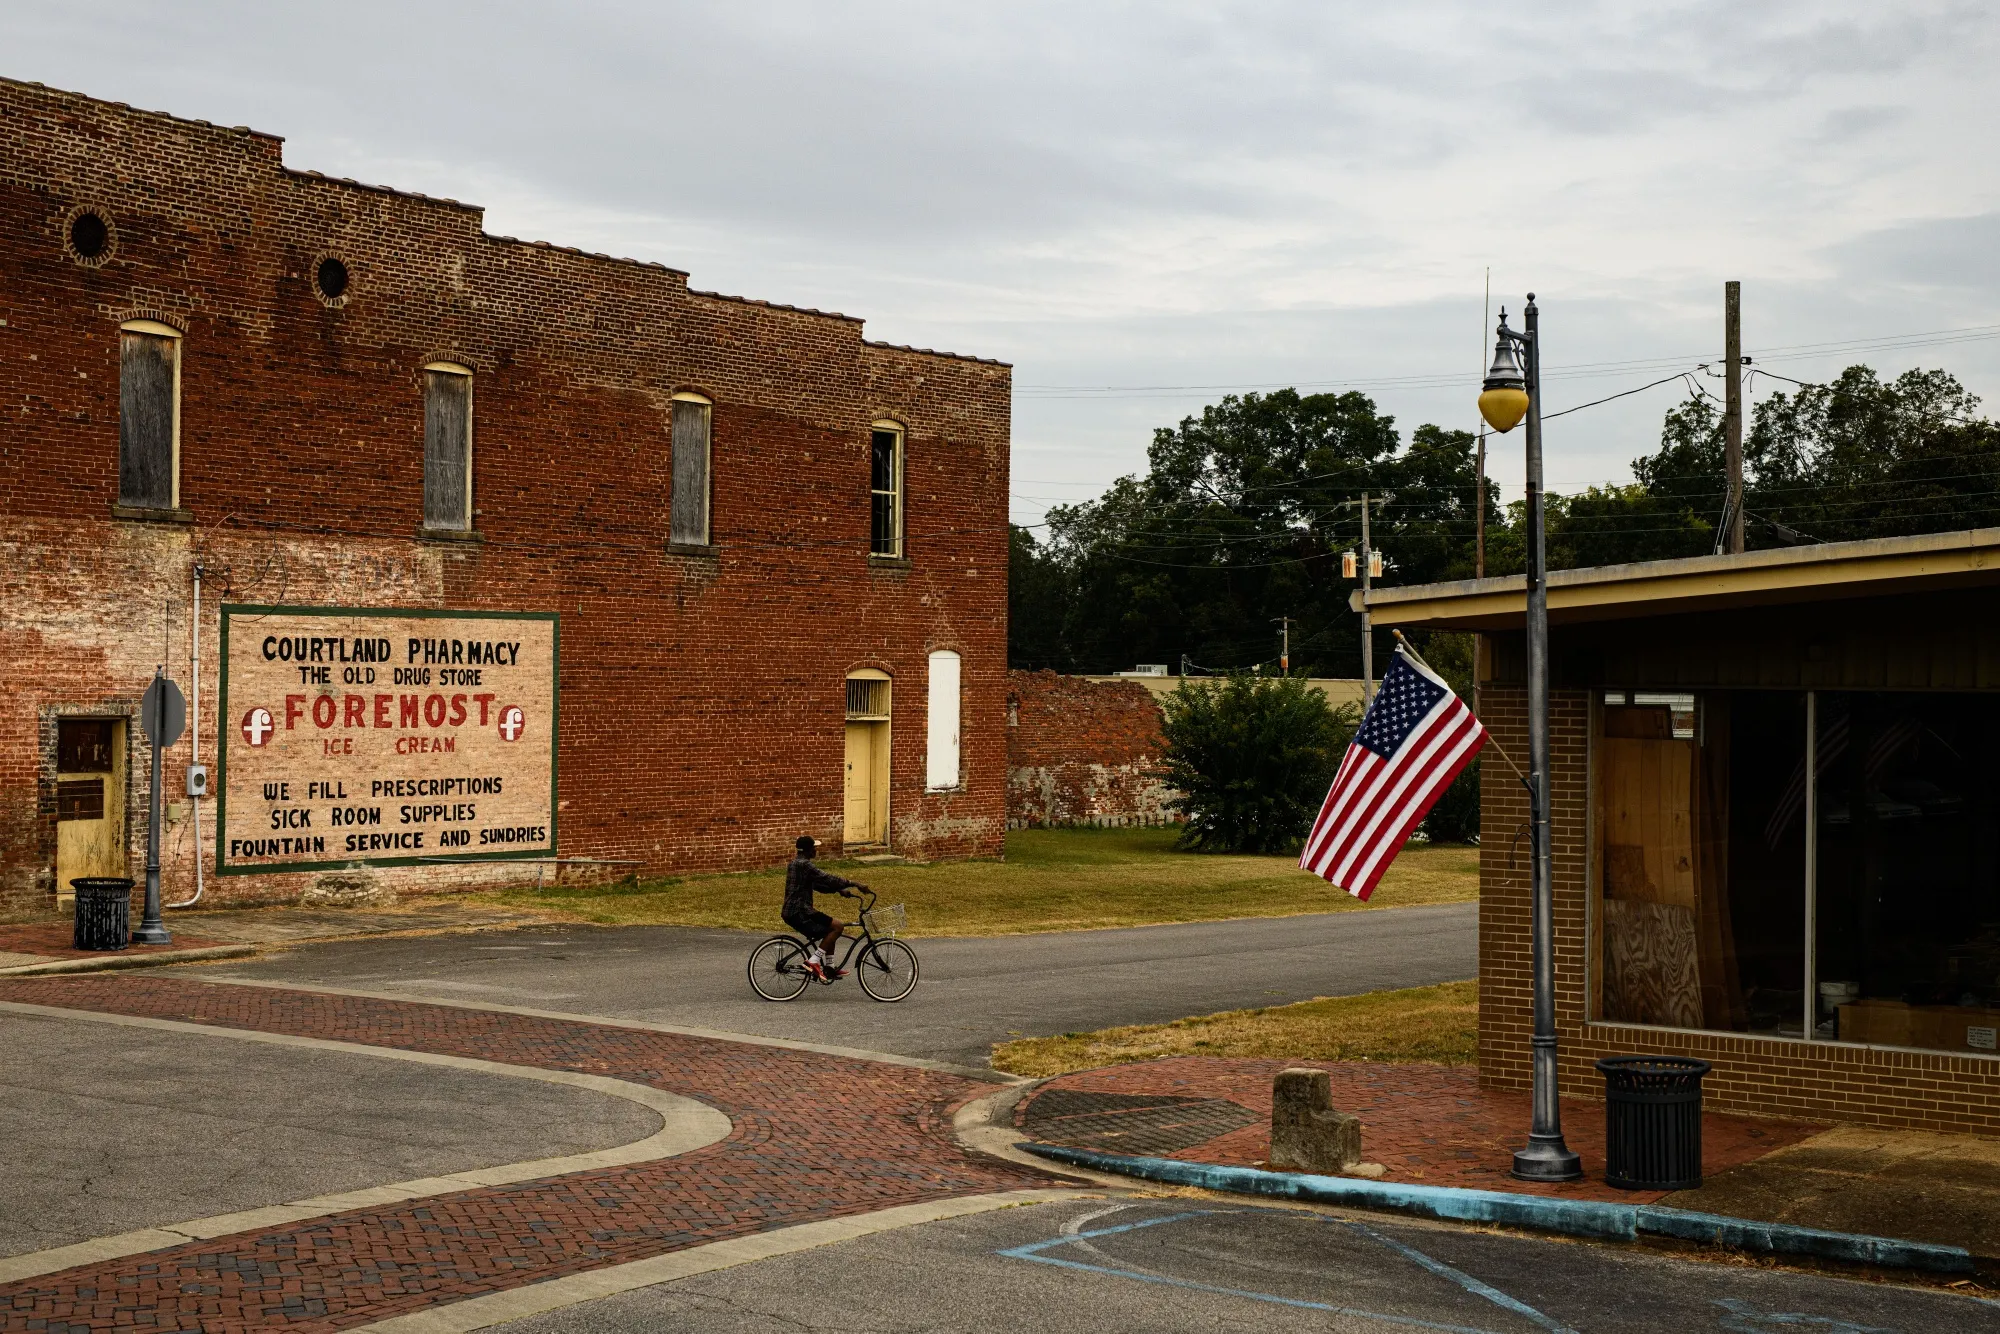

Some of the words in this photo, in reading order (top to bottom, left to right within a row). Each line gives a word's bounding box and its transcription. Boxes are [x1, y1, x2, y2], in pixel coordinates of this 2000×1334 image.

[263, 636, 390, 662] COURTLAND
[408, 639, 520, 666] PHARMACY
[299, 666, 331, 684] THE
[344, 667, 375, 685] OLD
[394, 668, 430, 685] DRUG
[440, 669, 482, 686] STORE
[285, 694, 495, 730] FOREMOST
[324, 738, 352, 755] ICE
[396, 737, 455, 755] CREAM
[263, 783, 289, 800] WE
[308, 782, 347, 799] FILL
[372, 777, 503, 798] PRESCRIPTIONS
[271, 809, 311, 830] SICK
[331, 808, 381, 826] ROOM
[400, 804, 476, 824] SUPPLIES
[231, 837, 325, 857] FOUNTAIN
[345, 832, 424, 851] SERVICE
[439, 830, 470, 847] AND
[480, 827, 546, 845] SUNDRIES
